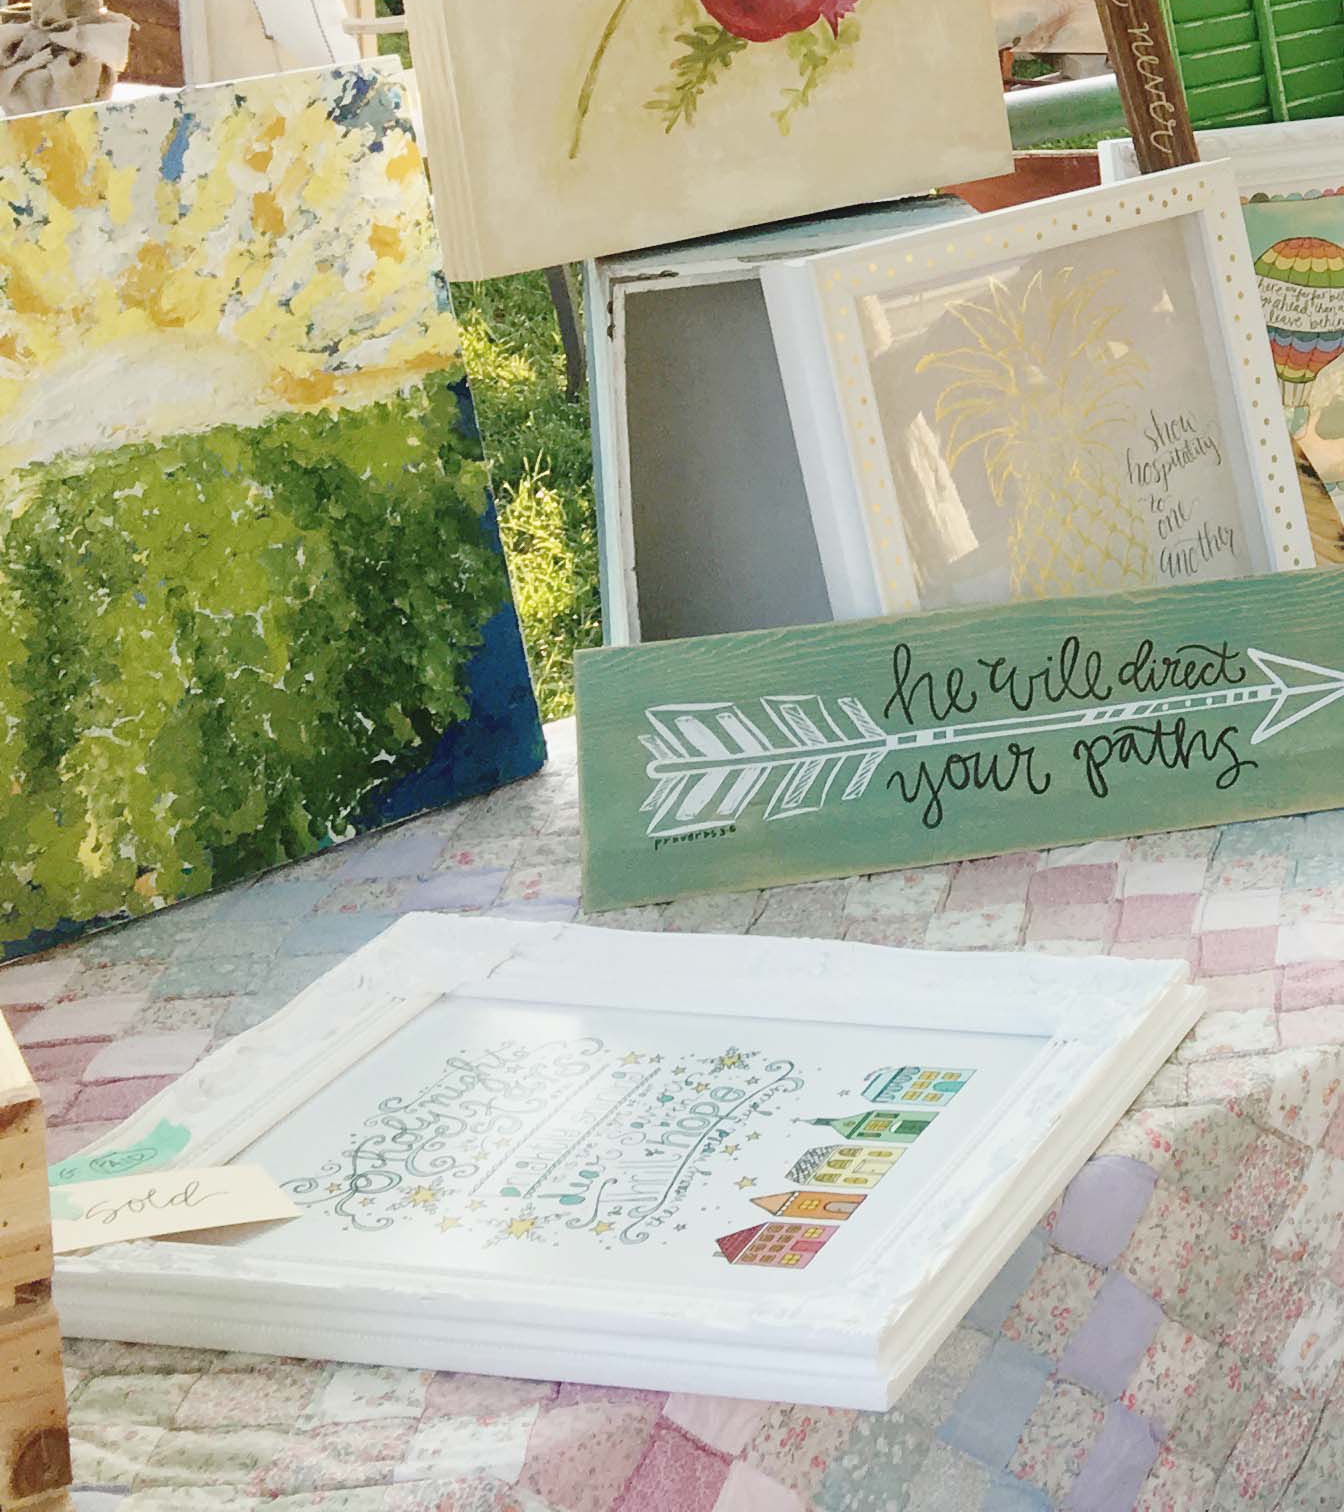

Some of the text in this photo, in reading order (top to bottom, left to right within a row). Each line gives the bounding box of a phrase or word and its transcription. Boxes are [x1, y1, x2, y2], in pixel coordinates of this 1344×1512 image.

[1126, 22, 1178, 156] never
[1143, 408, 1197, 453] show
[1126, 433, 1223, 492] hospitality
[1158, 496, 1200, 540] one
[1160, 522, 1239, 579] another
[884, 635, 1248, 724] he will direct
[886, 714, 1260, 829] your paths
[644, 1085, 748, 1147] hope
[85, 1180, 232, 1225] sold
